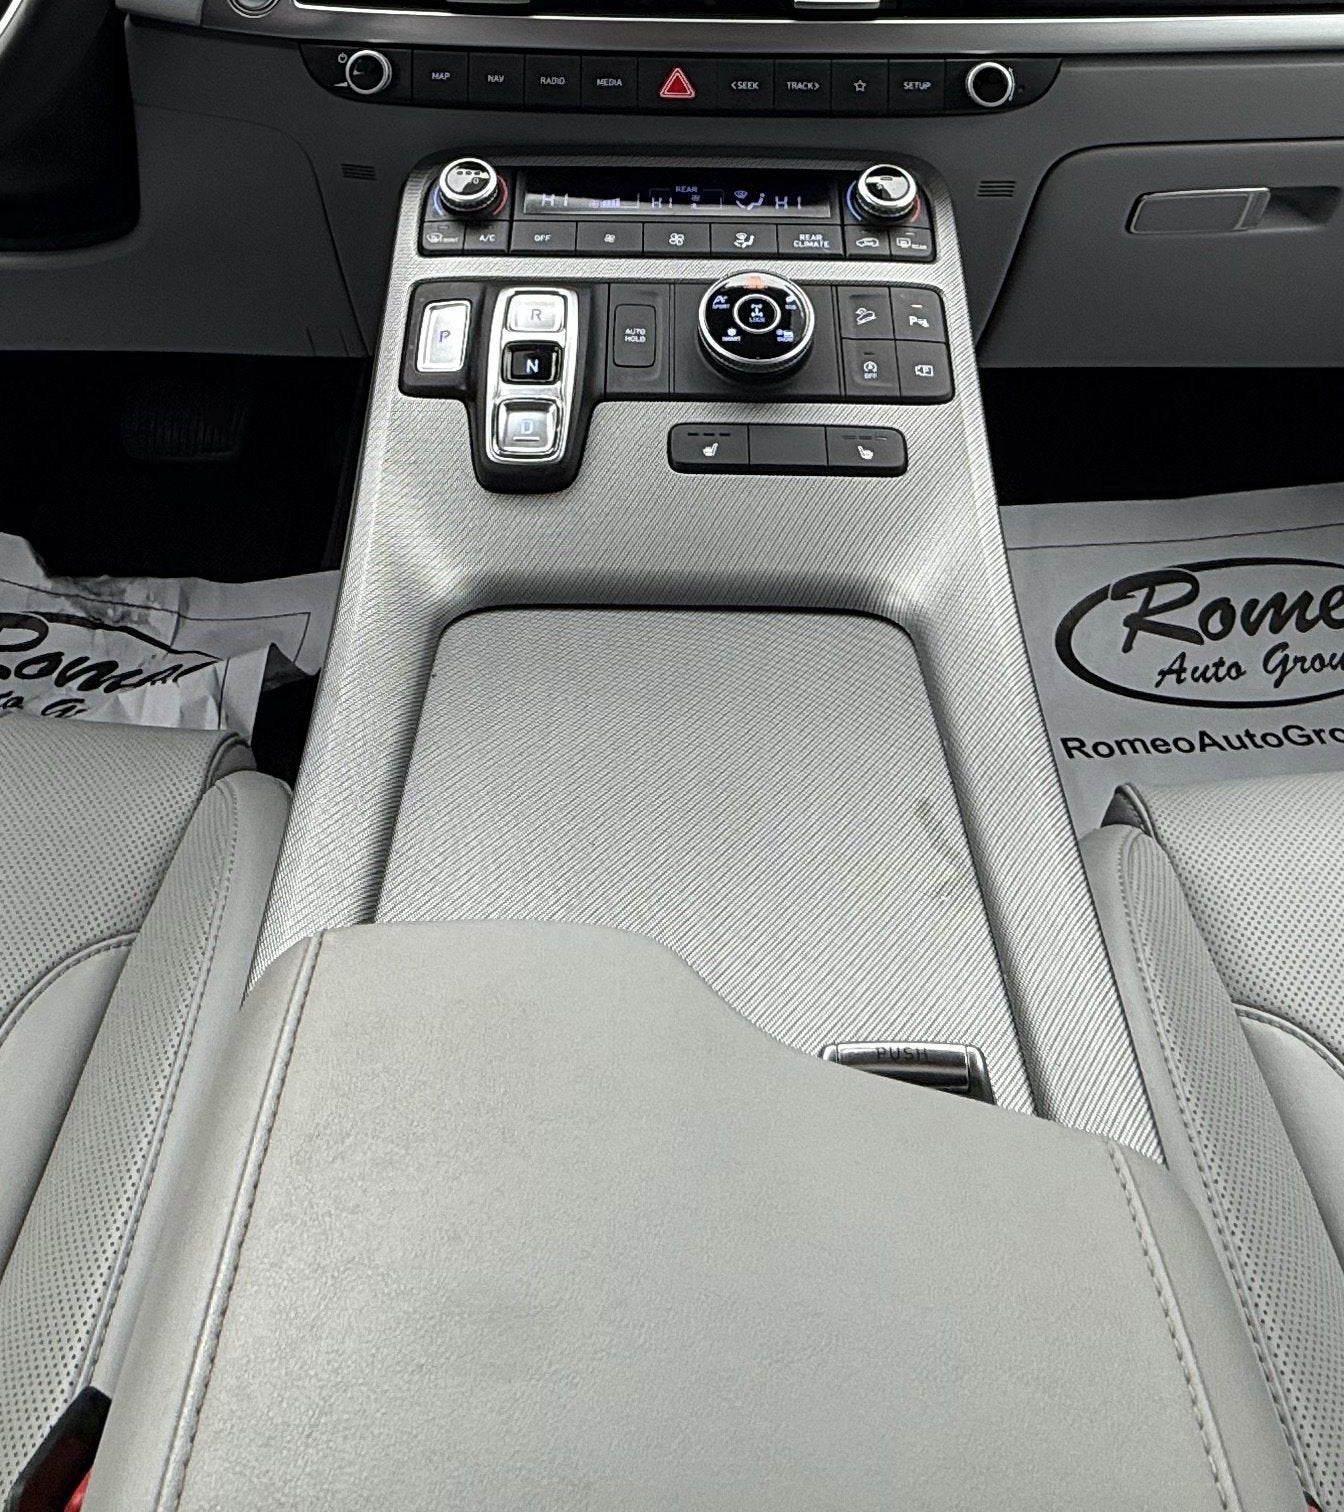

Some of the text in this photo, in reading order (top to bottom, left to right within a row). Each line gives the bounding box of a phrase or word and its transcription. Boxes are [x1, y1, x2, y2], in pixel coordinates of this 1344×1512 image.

[431, 71, 450, 81] MAP
[487, 74, 505, 84] NAV
[540, 76, 565, 86] RADIO
[596, 77, 623, 88] MEDIA
[903, 80, 932, 90] SETUP
[479, 233, 496, 242] A/C
[534, 234, 552, 242] OFF
[793, 241, 831, 249] CLIMATE
[531, 308, 542, 321] R
[439, 330, 451, 343] P
[526, 358, 540, 373] N
[520, 419, 534, 435] D
[1155, 650, 1247, 689] Auto
[876, 1046, 929, 1062] PUSH
